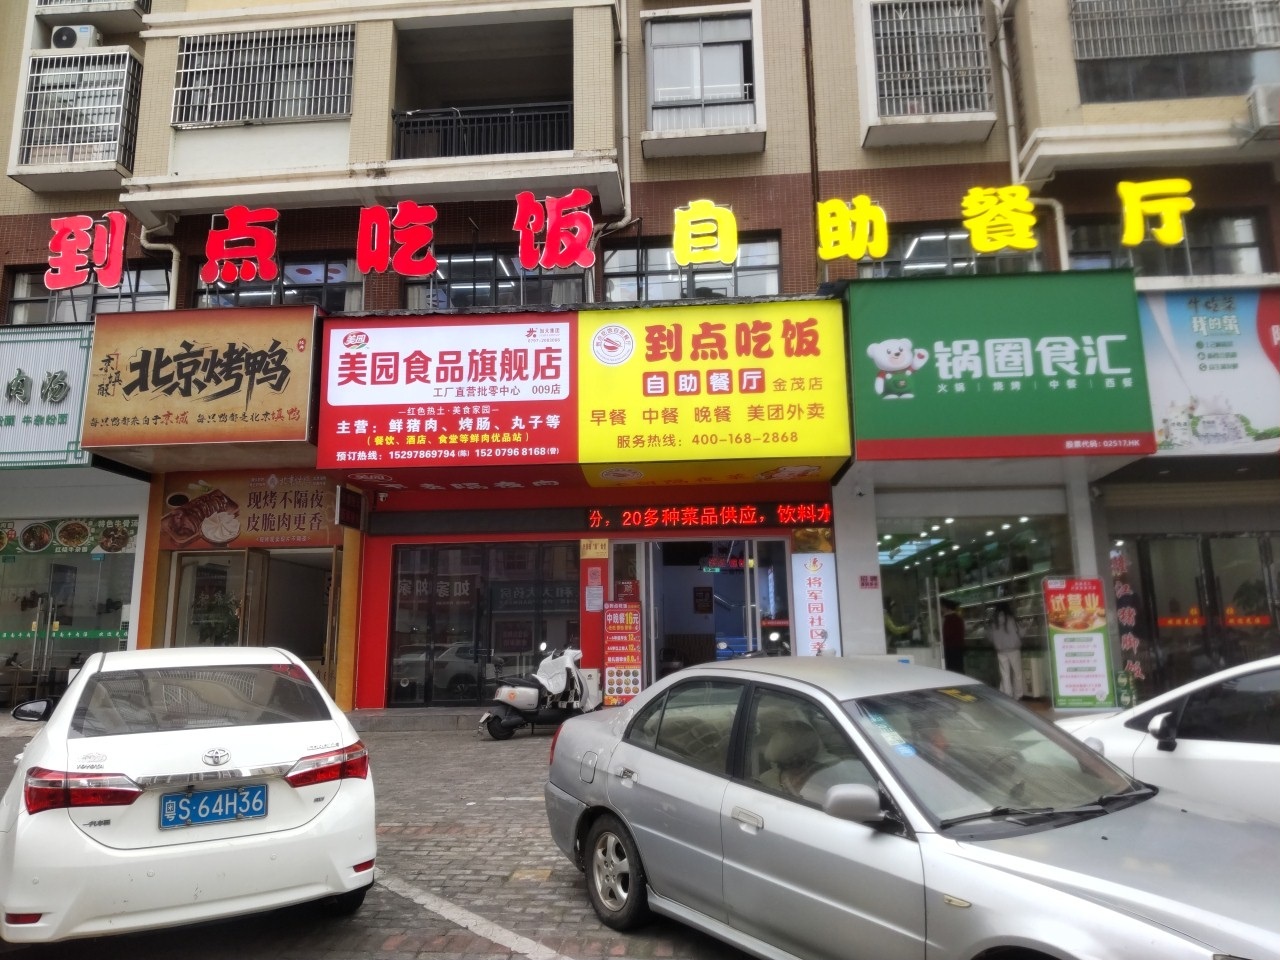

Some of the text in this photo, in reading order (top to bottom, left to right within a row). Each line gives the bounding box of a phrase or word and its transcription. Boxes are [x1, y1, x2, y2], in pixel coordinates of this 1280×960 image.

[44, 178, 1195, 291] 到点吃饭 自助餐厅
[645, 318, 821, 362] 到点吃饭
[338, 347, 561, 386] 美园食品旗舰店
[934, 335, 1131, 379] 锅圈食汇
[123, 339, 291, 405] 北京烤鸭
[646, 371, 823, 395] 自助餐厅 金茂店
[433, 384, 561, 397] 工厂直营批零中心 009店
[590, 404, 825, 427] 早餐 中餐 晚餐 美团外卖
[692, 432, 798, 446] 400-168-2868
[247, 489, 324, 509] 现烤不隔夜
[247, 512, 323, 532] 皮脆肉更香
[1050, 593, 1099, 612] 试营业
[164, 788, 265, 822] 粤S·64H36
